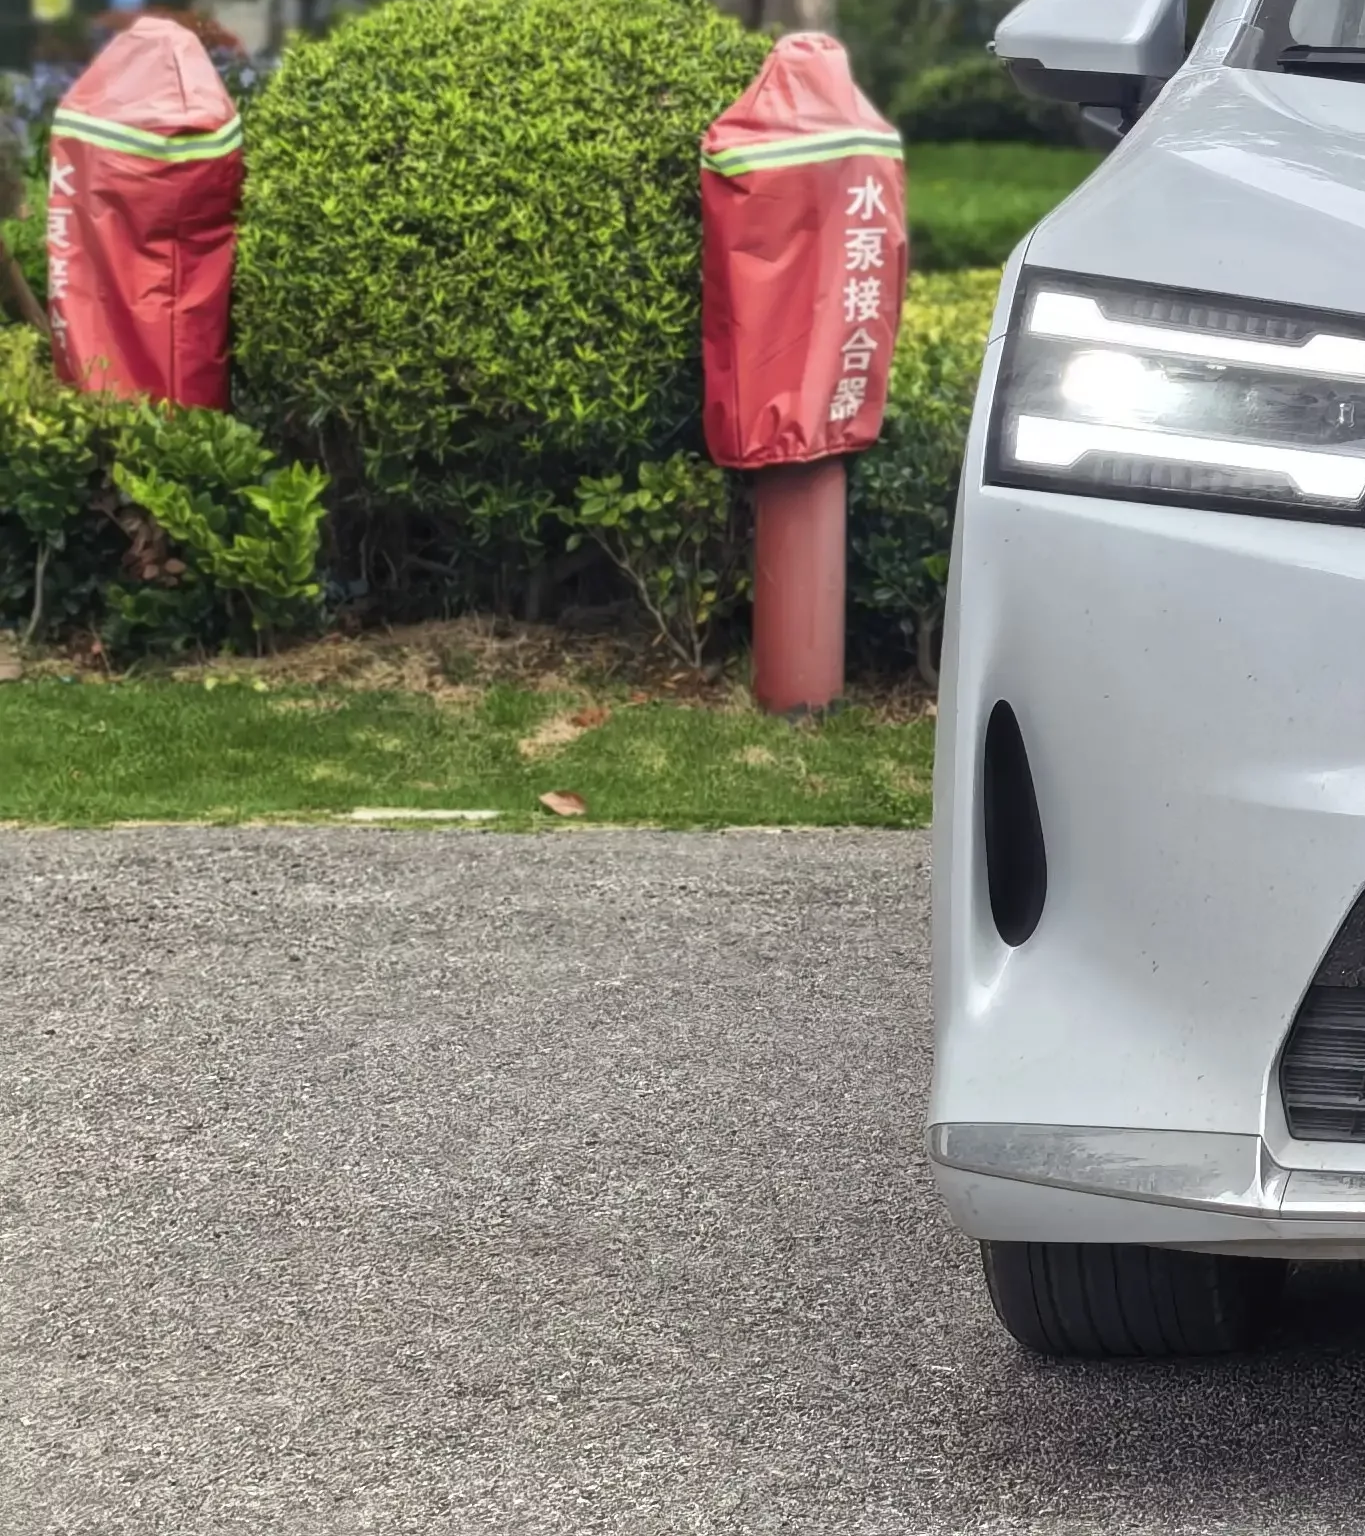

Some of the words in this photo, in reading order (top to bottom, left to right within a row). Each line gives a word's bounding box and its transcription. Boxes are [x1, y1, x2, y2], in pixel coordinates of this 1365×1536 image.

[829, 175, 888, 423] 水泵接合器
